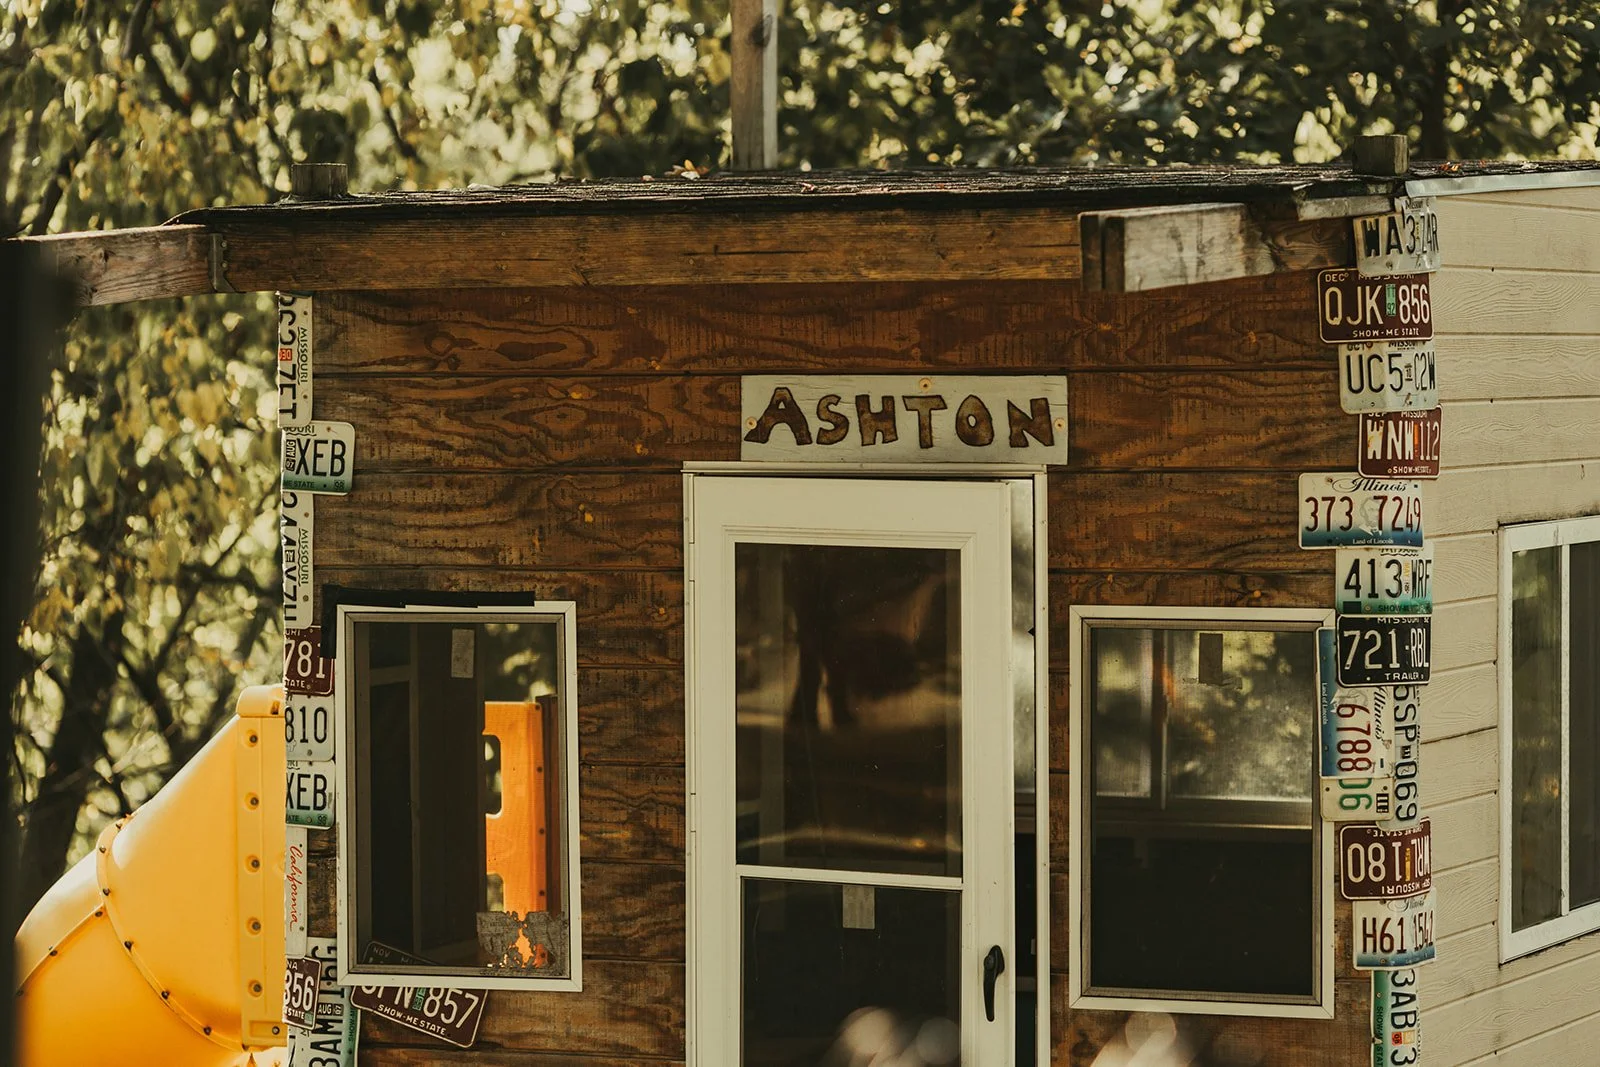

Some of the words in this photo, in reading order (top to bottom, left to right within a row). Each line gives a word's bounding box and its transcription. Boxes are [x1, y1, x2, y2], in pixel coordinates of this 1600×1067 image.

[1325, 274, 1345, 283] DEC
[1325, 285, 1384, 326] QJK
[1399, 283, 1430, 324] 856
[1401, 328, 1420, 336] STATE
[300, 327, 308, 383] MISSOURI
[1346, 353, 1404, 394] UC5
[1413, 351, 1436, 391] C2W
[743, 386, 1055, 449] ASHTON
[287, 440, 296, 457] AUG
[295, 438, 346, 477] XEB
[1366, 419, 1414, 460] WNW
[1419, 420, 1439, 460] 112
[1332, 478, 1407, 493] Illinois
[1305, 496, 1354, 532] 373
[1373, 495, 1421, 533] 7249
[301, 529, 309, 584] MISSOURI
[1344, 558, 1403, 599] 413
[1411, 559, 1431, 599] WRF
[1343, 629, 1401, 670] 721
[1410, 627, 1429, 668] RBL
[1385, 672, 1419, 681] TRAILER
[285, 706, 328, 744] 810
[1336, 703, 1372, 772] 6788
[1394, 760, 1417, 821] 069
[1347, 841, 1402, 883] 180
[286, 846, 304, 932] California
[1381, 882, 1420, 895] MISSOURI
[373, 946, 391, 958] NOV
[1362, 917, 1407, 954] H61
[1413, 909, 1433, 951] 1541
[318, 1004, 332, 1014] AUG
[419, 1020, 447, 1036] STATE
[422, 986, 480, 1029] 857
